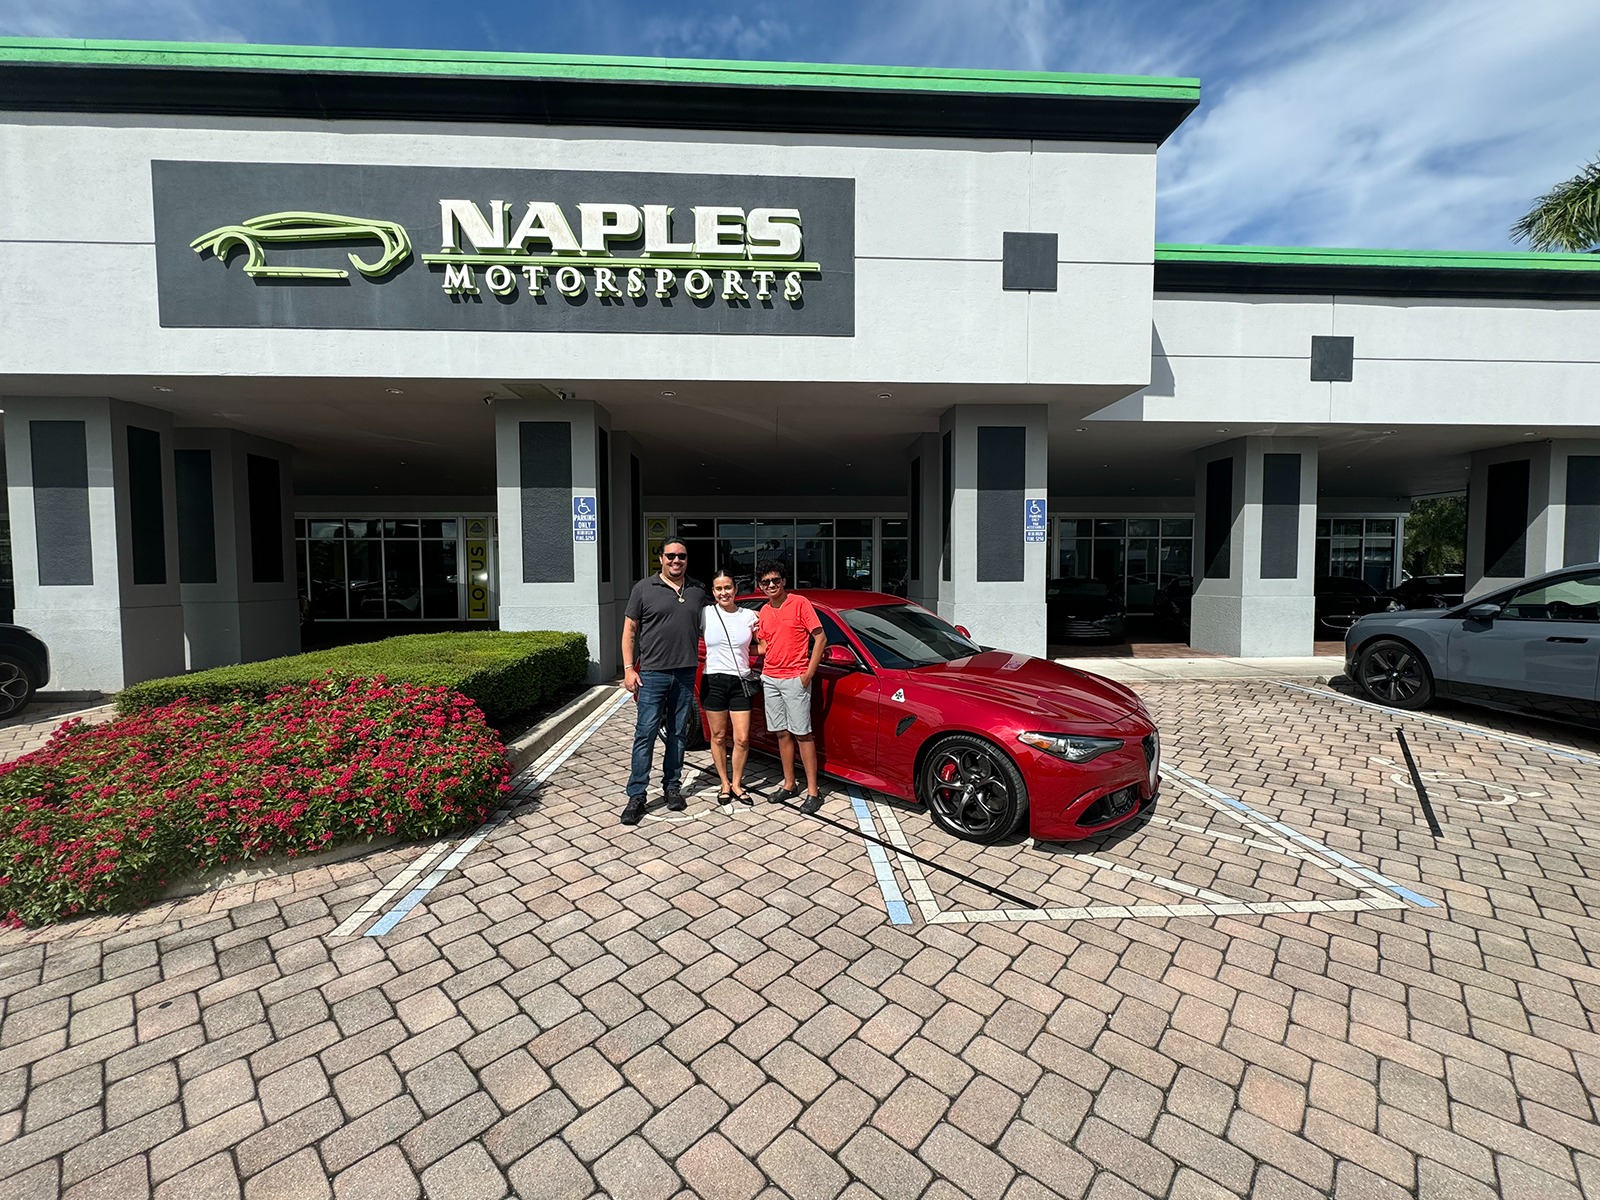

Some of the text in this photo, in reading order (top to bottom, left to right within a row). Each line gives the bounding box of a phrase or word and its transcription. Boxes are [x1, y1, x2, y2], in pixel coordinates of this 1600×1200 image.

[439, 199, 802, 260] NAPLES
[442, 263, 803, 302] MOTORSPORTS
[578, 521, 592, 529] ONLY
[471, 546, 486, 612] LOTUS
